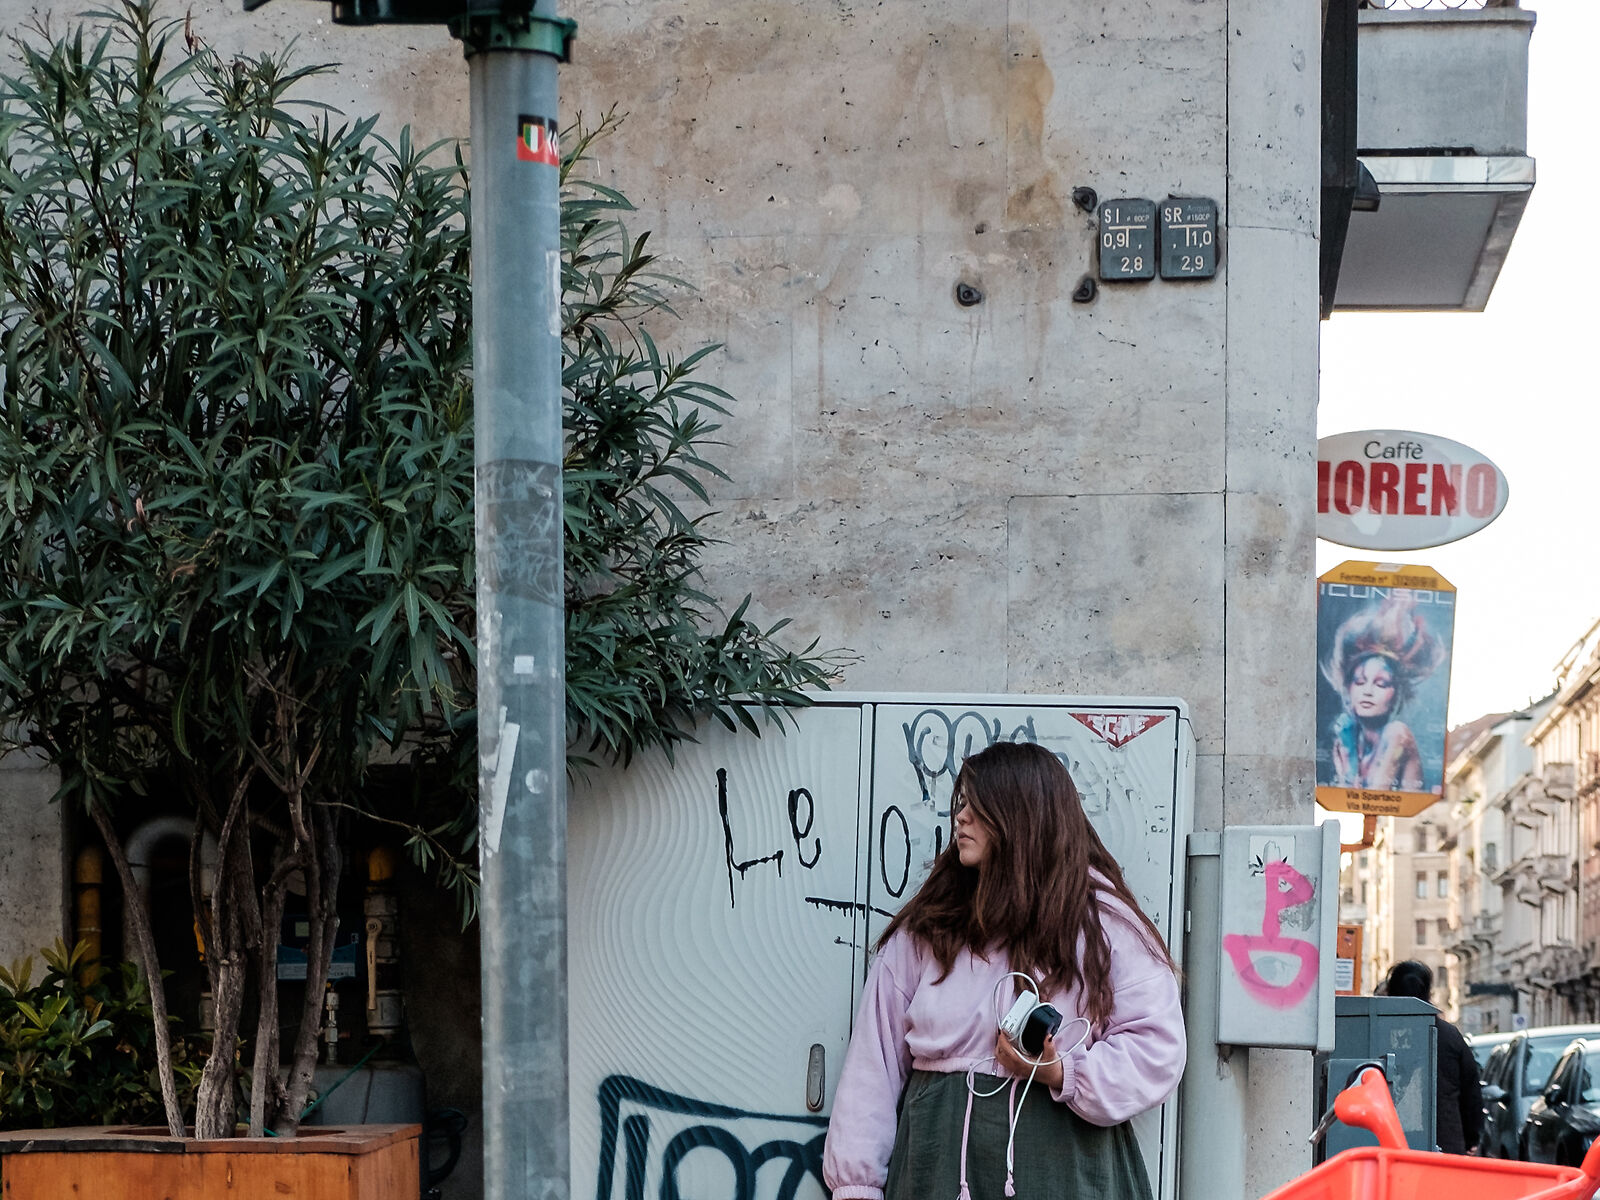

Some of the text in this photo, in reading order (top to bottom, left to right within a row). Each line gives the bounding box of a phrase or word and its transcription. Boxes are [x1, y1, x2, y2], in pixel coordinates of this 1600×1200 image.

[1164, 207, 1182, 223] SR
[1103, 232, 1126, 250] 0,9
[1191, 230, 1212, 249] 1,0
[1121, 256, 1143, 274] 2,8
[1181, 255, 1204, 273] 2,9
[1363, 440, 1424, 460] Caffè
[1345, 790, 1402, 803] Via Spartaco
[1346, 802, 1400, 813] Via Morosini
